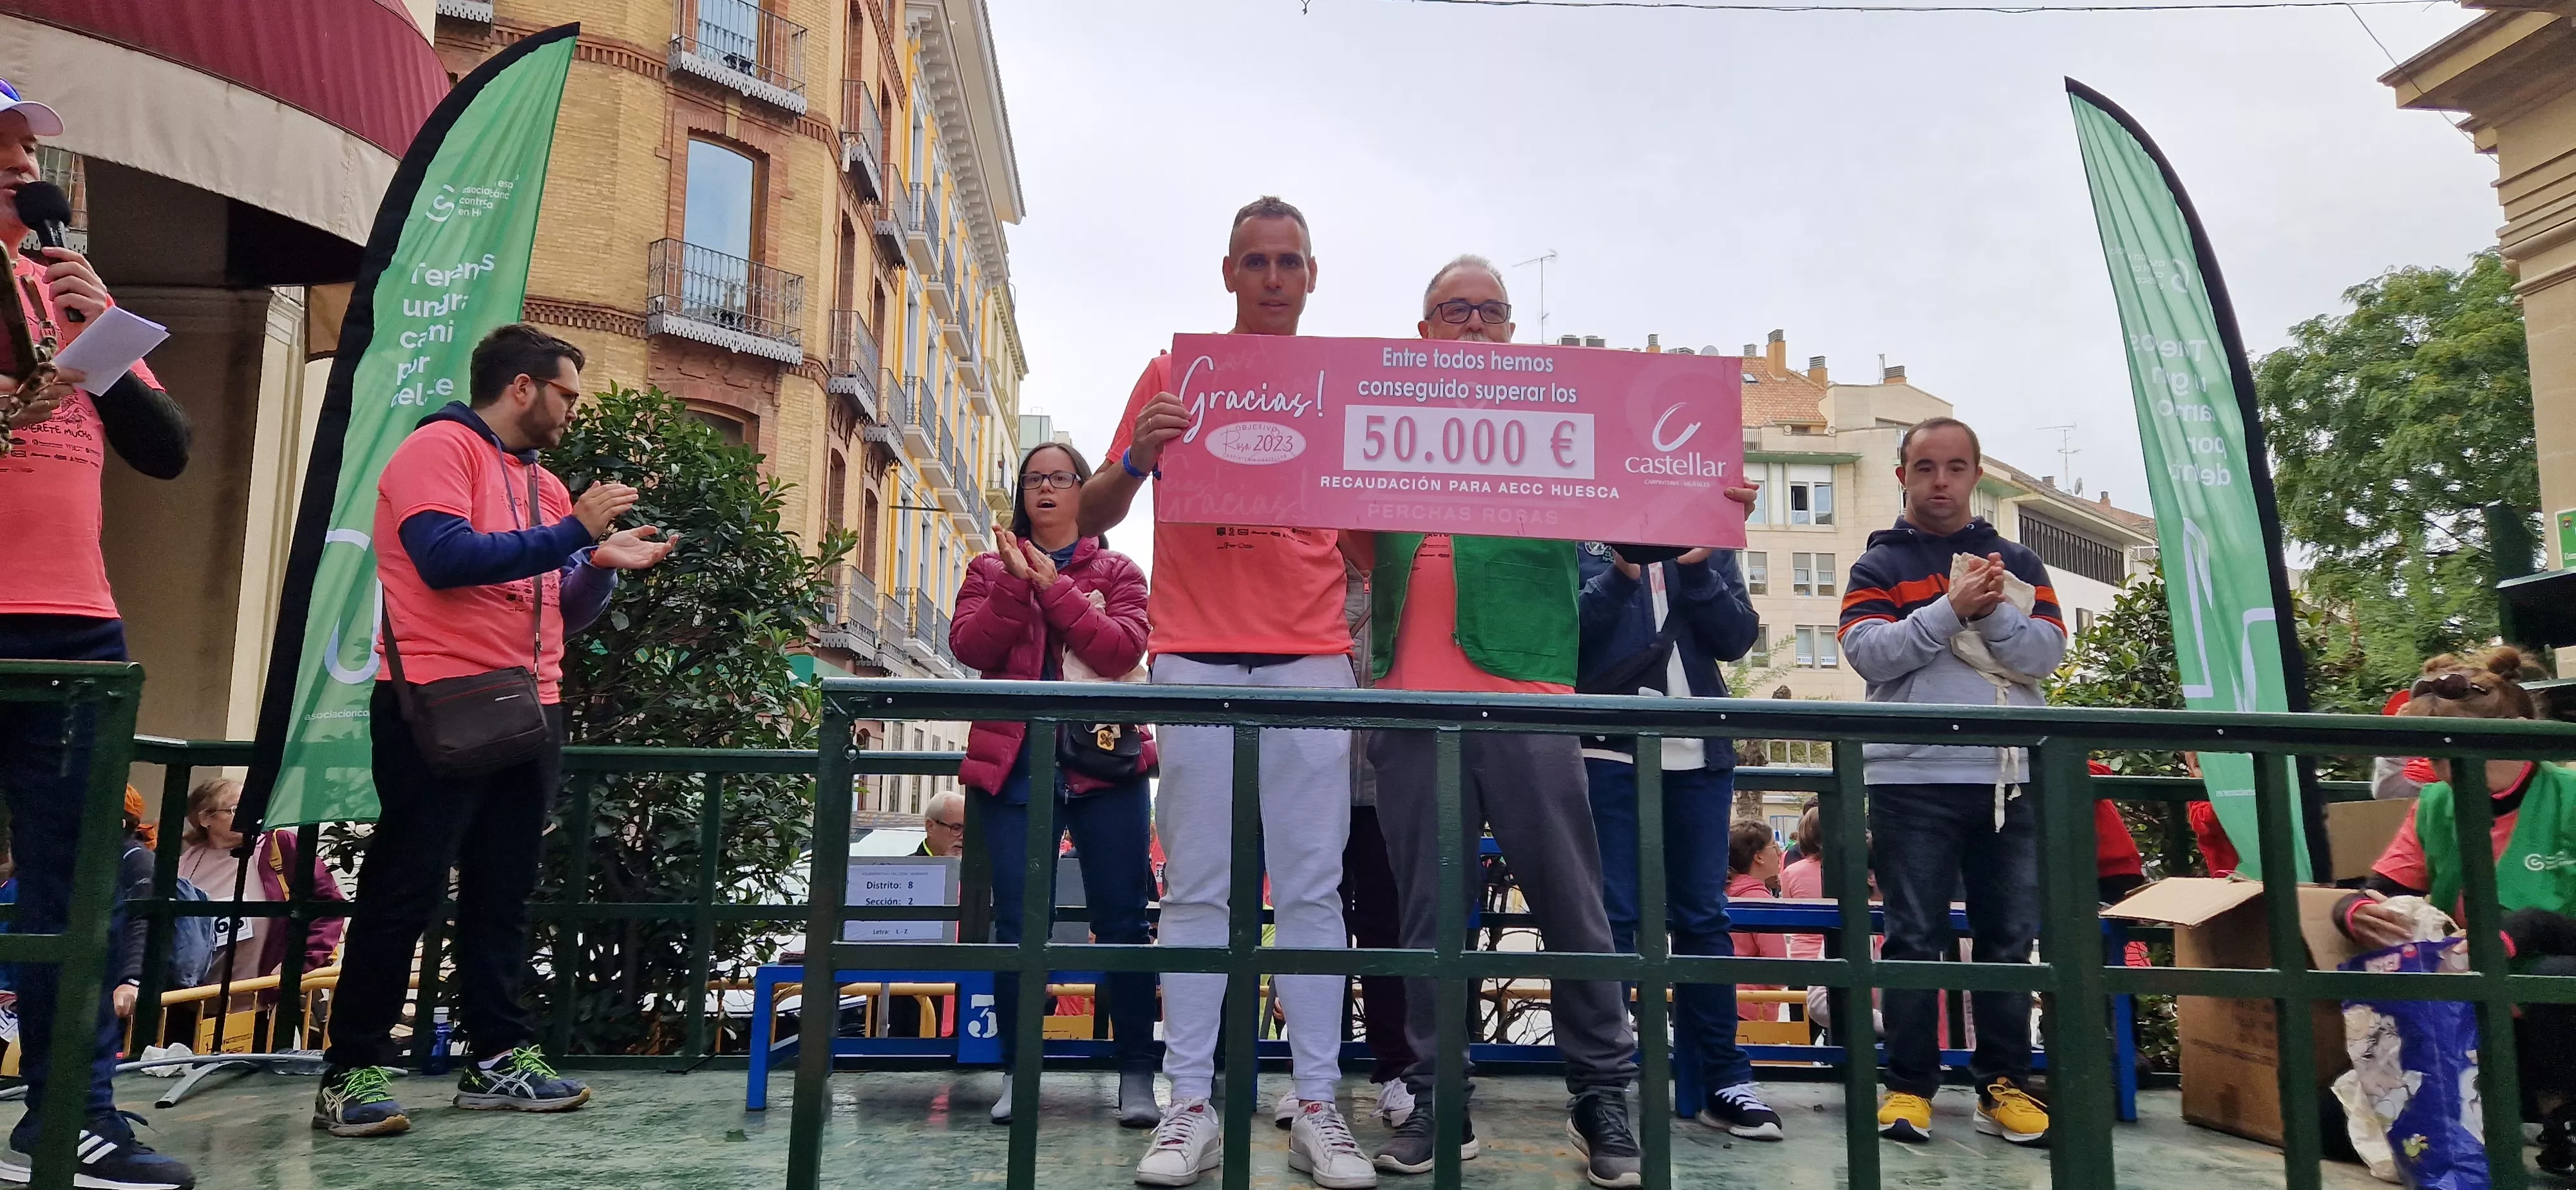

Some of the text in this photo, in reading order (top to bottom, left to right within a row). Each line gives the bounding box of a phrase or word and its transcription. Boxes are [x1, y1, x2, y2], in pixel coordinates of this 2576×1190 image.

[1383, 347, 1554, 373] Entre todos hemos
[1179, 355, 1325, 444] Gracias!
[1358, 377, 1577, 405] conseguido superar los
[64, 429, 93, 441] MUCHO
[1235, 424, 1278, 432] OBJETIVO
[1220, 429, 1293, 452] Rosa 2023
[1362, 415, 1577, 469] 50.000 €
[1625, 451, 1727, 477] castellar
[1320, 476, 1620, 499] RECAUDACIÓN PARA AECC HUESCA
[866, 881, 913, 889] Distrito: 8
[866, 897, 901, 905] Sección:
[967, 994, 998, 1038] 3
